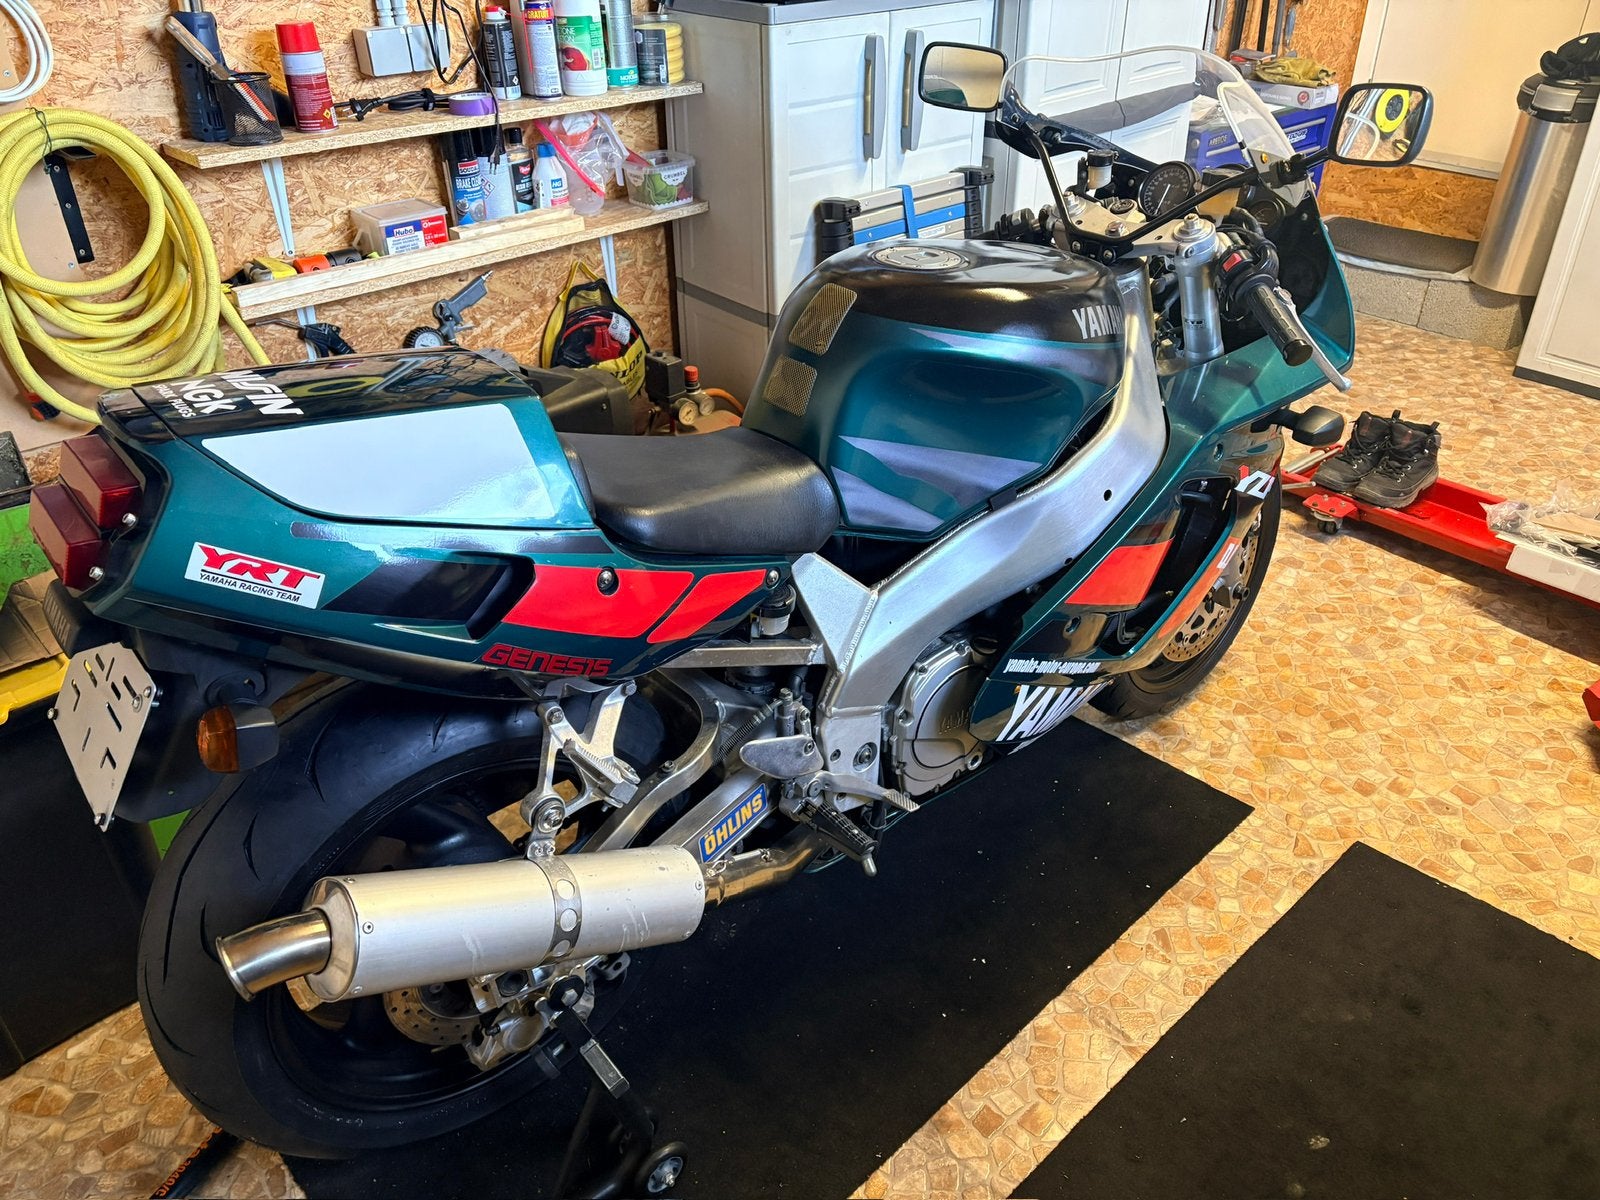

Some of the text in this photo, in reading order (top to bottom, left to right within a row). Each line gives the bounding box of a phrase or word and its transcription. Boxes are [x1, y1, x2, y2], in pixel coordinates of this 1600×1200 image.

[394, 227, 413, 237] Hubo
[168, 398, 197, 418] PLUGS
[170, 379, 237, 414] NGK
[198, 544, 321, 589] YRT
[200, 572, 301, 603] YAMAHA RACING TEAM
[481, 643, 613, 677] GENESIS
[704, 793, 763, 856] ÖHLINS
